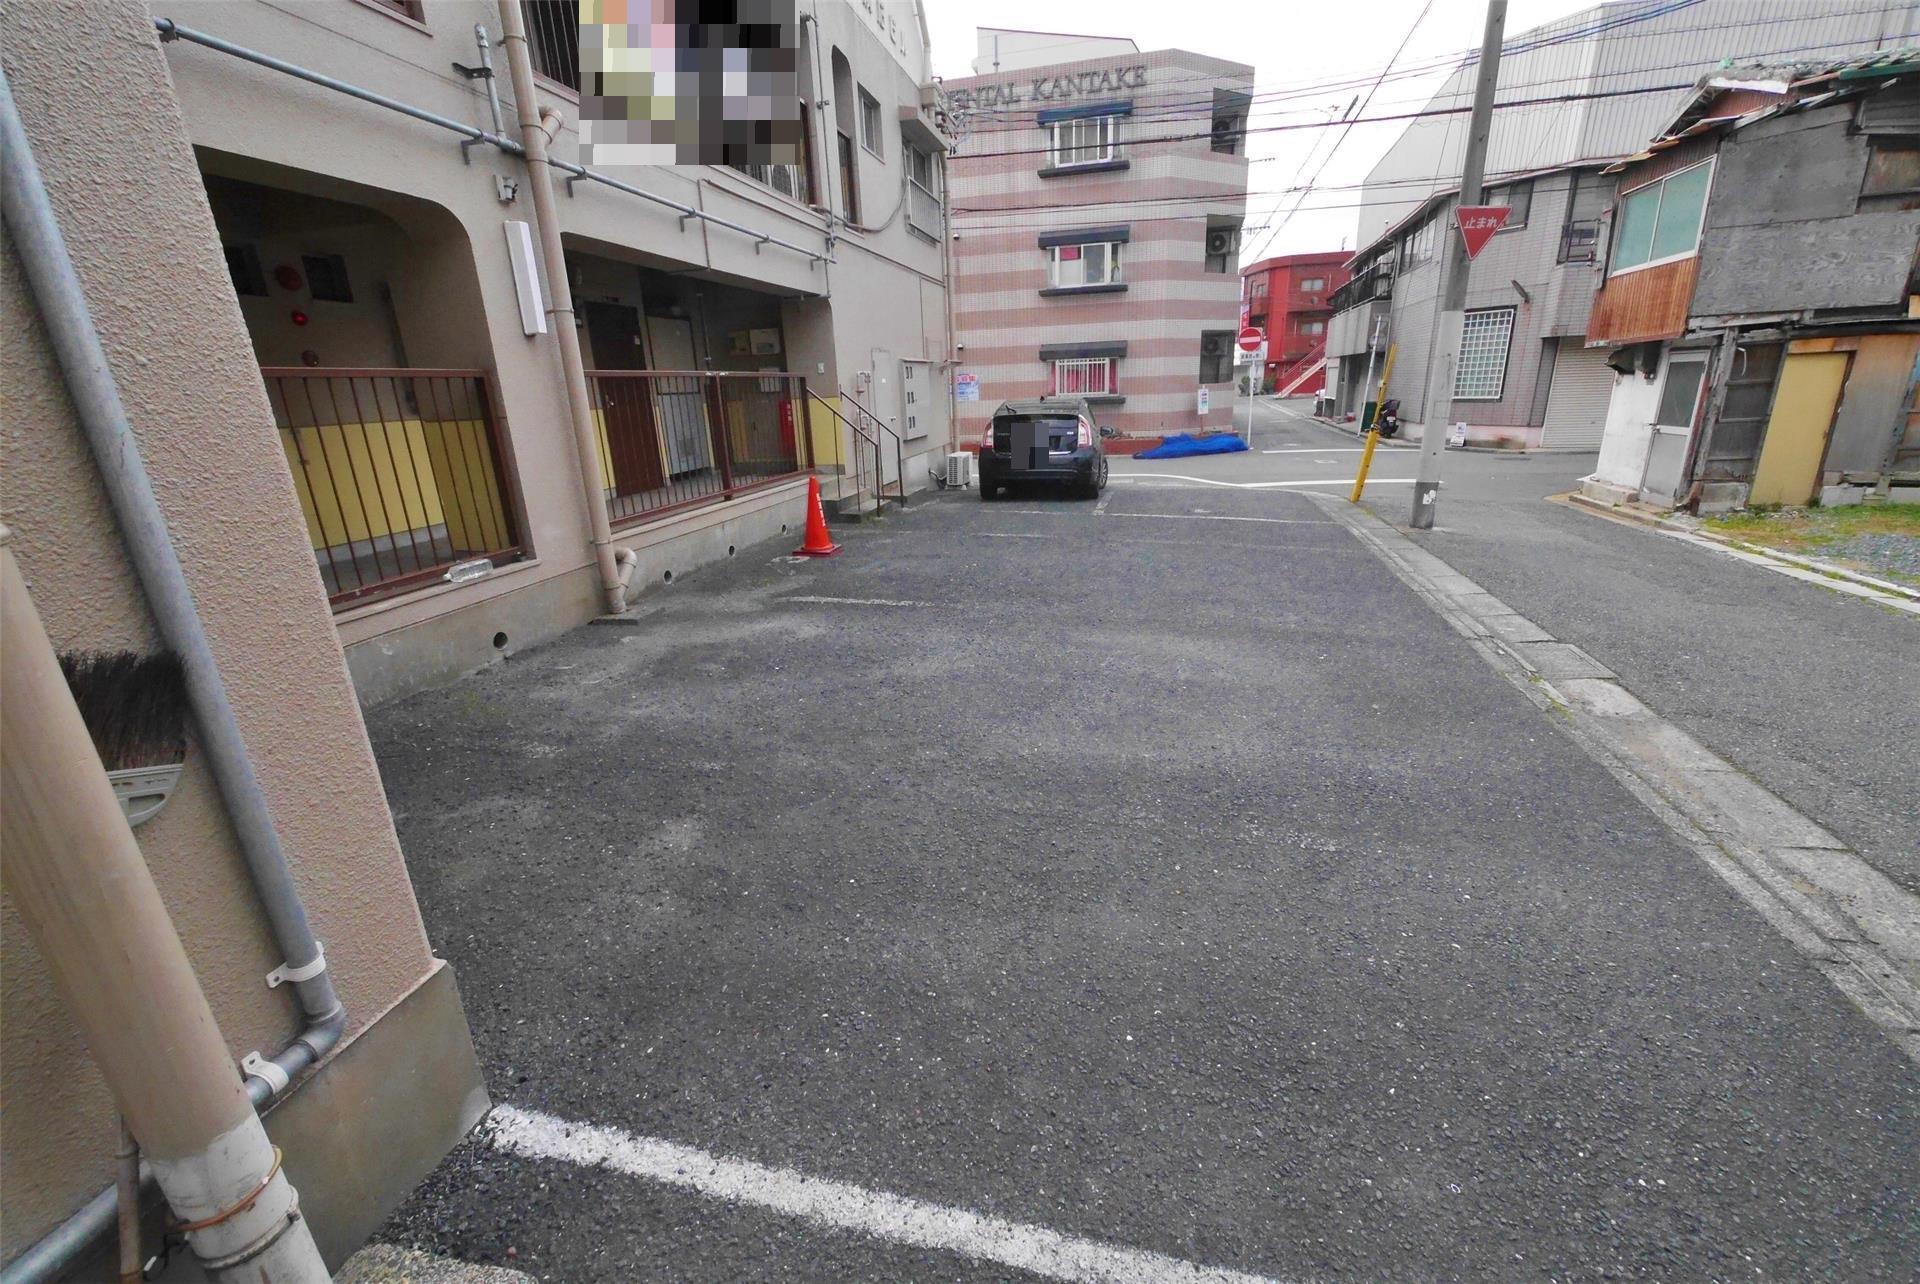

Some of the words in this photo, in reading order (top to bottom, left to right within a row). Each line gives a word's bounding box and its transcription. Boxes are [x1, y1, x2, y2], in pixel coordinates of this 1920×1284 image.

[1031, 65, 1148, 101] KANTAKE
[1463, 215, 1498, 229] 止まれ
